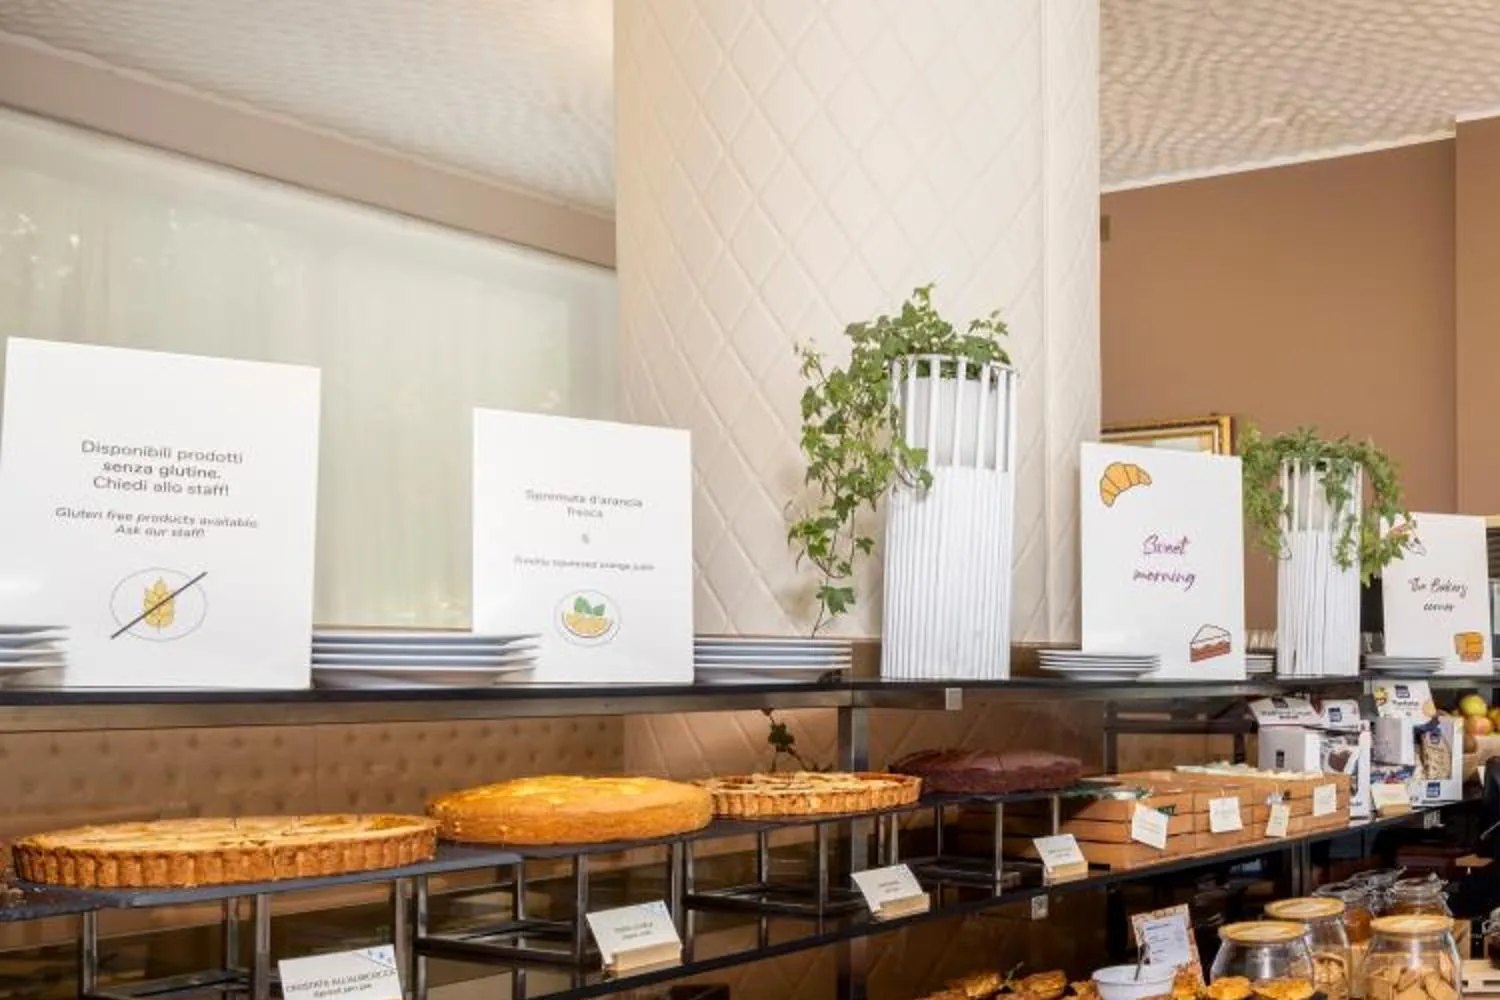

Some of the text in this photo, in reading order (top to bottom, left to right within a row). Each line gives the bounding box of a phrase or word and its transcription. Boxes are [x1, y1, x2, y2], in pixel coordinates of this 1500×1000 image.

[81, 439, 244, 465] Disponibili prodotti
[102, 461, 222, 480] senza glutine.
[93, 476, 230, 498] Chiedi allo staff!
[1133, 569, 1195, 592] morning
